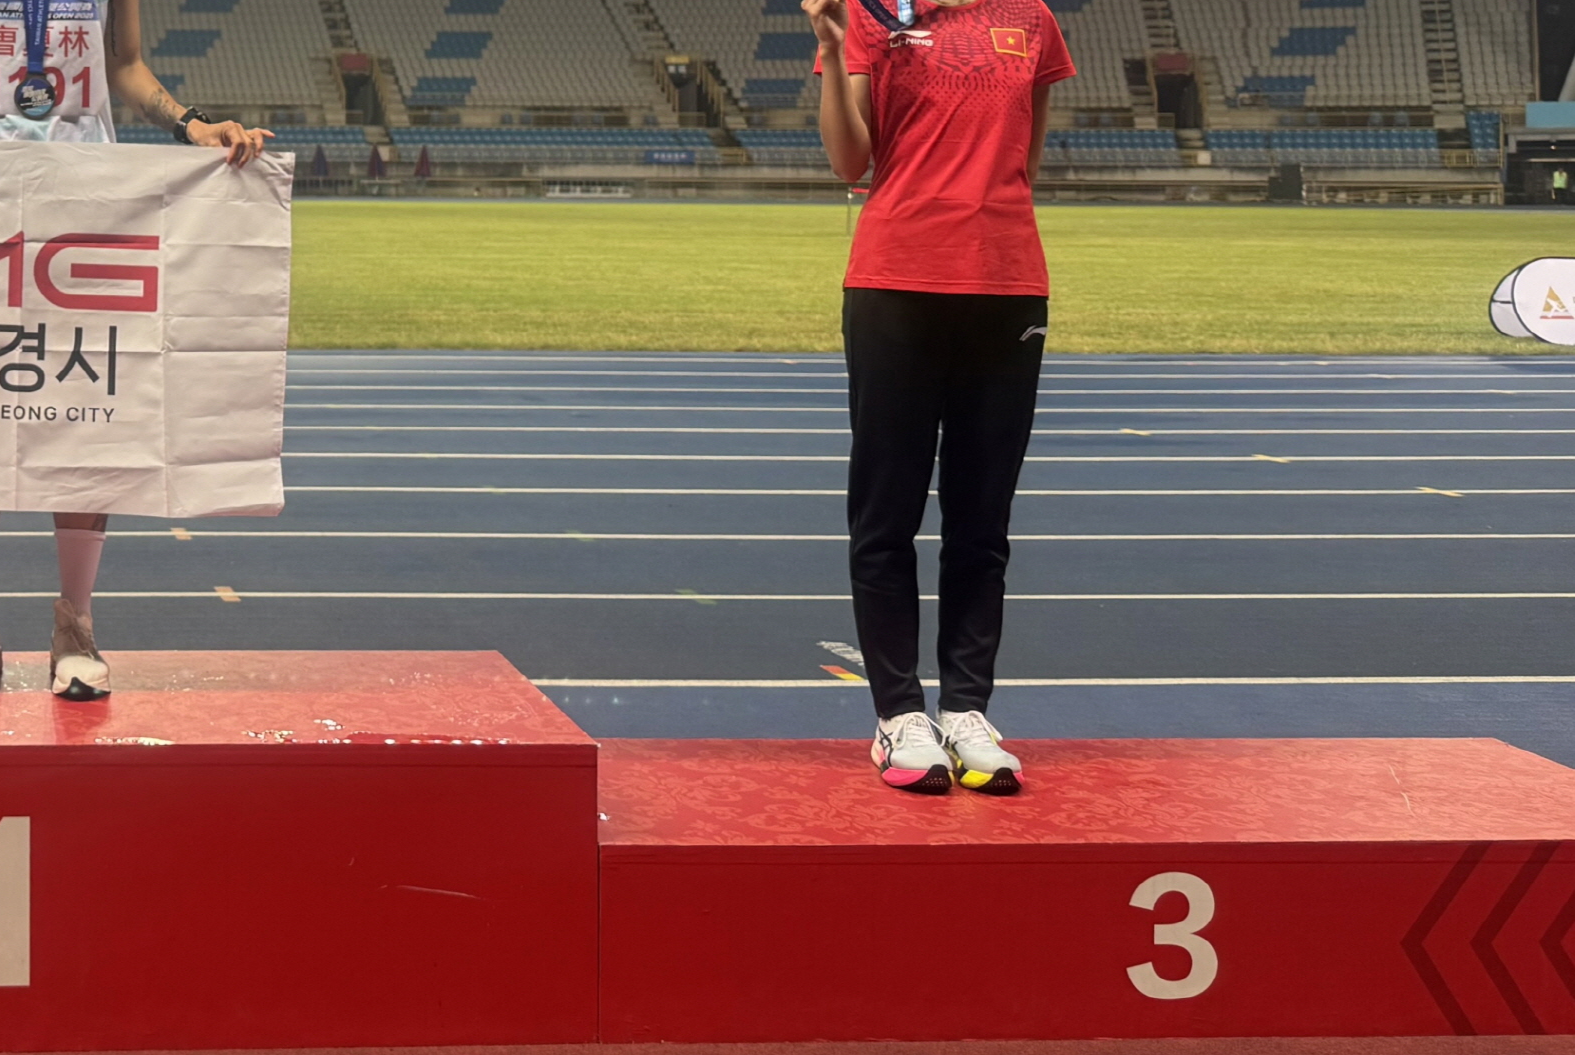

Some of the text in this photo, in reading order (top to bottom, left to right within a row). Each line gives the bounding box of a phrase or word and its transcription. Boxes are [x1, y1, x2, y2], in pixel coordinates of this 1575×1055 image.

[52, 11, 74, 20] OPEN
[65, 407, 115, 423] CITY
[1127, 871, 1218, 999] 3
